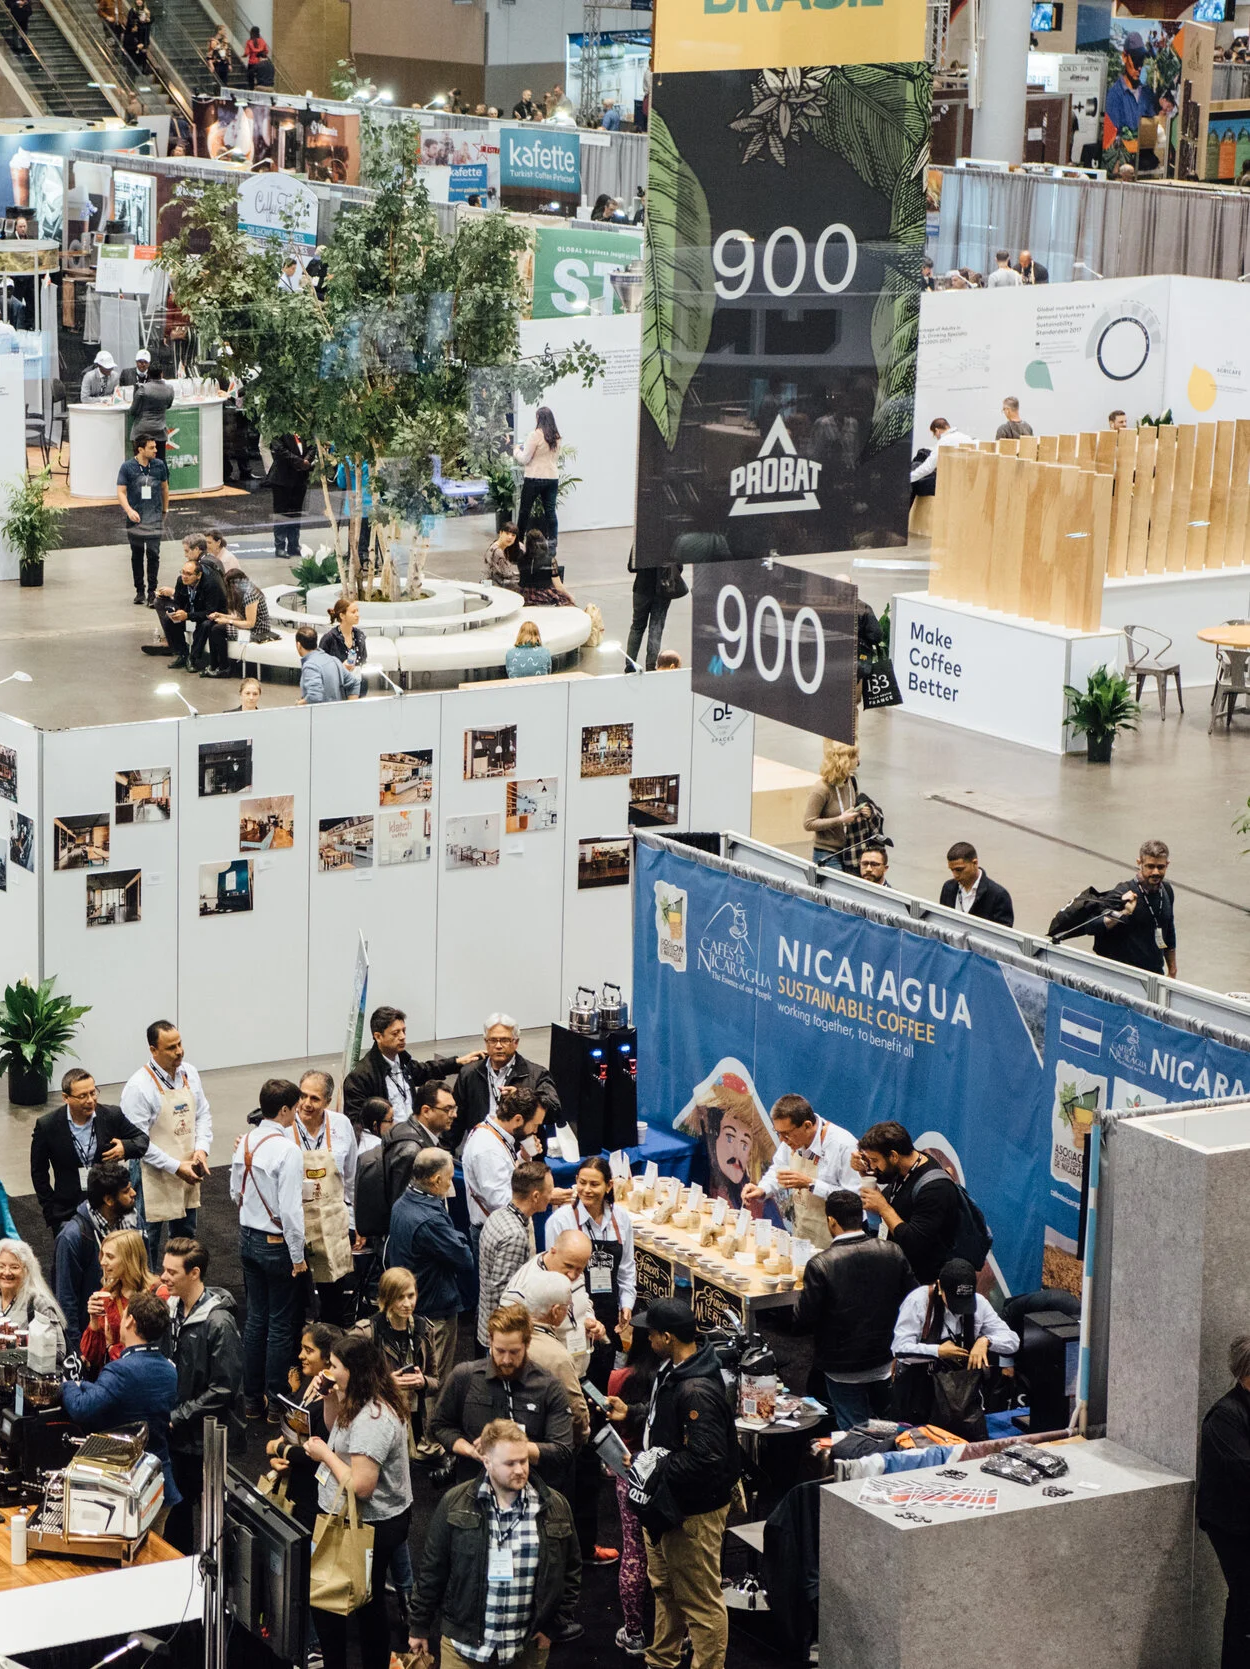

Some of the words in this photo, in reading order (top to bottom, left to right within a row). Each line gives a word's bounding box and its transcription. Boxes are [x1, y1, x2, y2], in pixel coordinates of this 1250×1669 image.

[450, 167, 483, 177] kafette
[509, 138, 575, 173] kafette
[557, 246, 583, 254] GLOBAL
[713, 222, 859, 300] 900
[730, 457, 822, 496] PROBAT
[716, 584, 825, 695] 900
[910, 622, 952, 649] Make
[909, 648, 962, 677] Coffee
[868, 695, 894, 706] FRANCE
[908, 672, 959, 702] Better
[698, 948, 772, 990] NICARAGUA
[778, 935, 972, 1030] NICARAGUA
[778, 975, 873, 1026] SUSTAINABLE
[876, 1009, 936, 1045] COFFEE
[777, 1003, 811, 1026] working
[813, 1013, 855, 1040] together,
[858, 1030, 868, 1041] to
[869, 1031, 901, 1053] benefit
[903, 1044, 914, 1058] all
[1055, 1143, 1084, 1163] ASOCIAC
